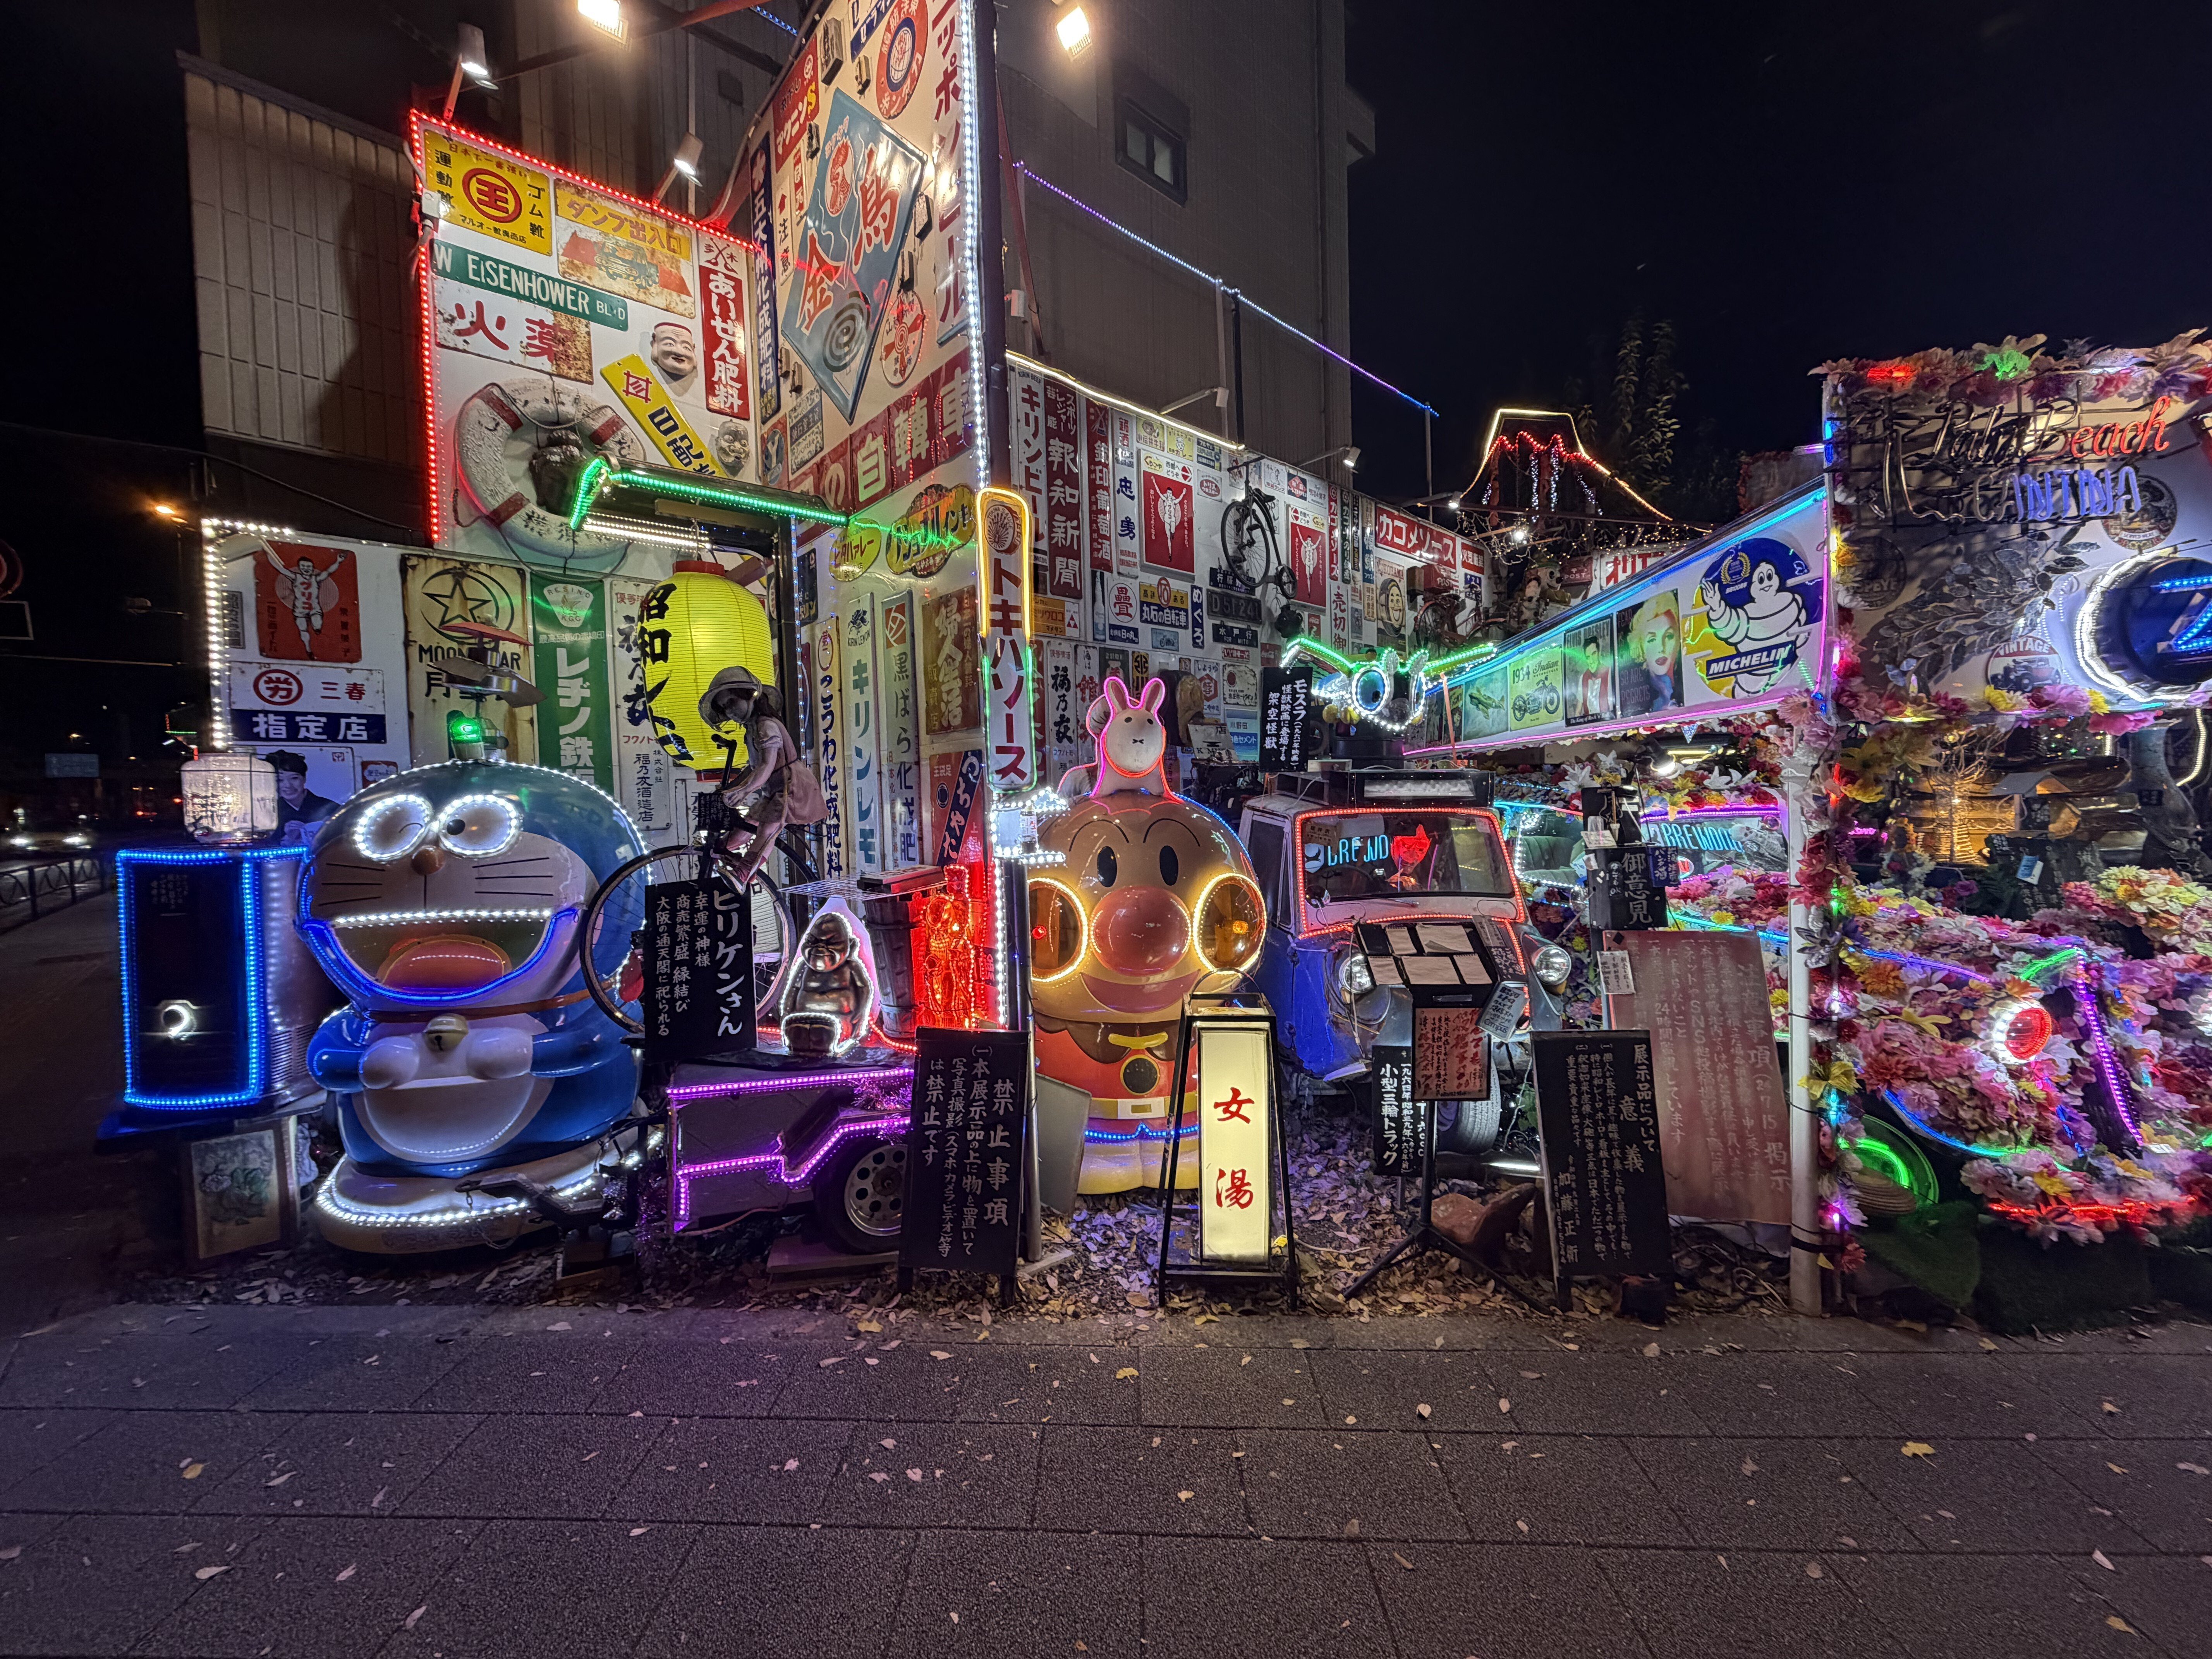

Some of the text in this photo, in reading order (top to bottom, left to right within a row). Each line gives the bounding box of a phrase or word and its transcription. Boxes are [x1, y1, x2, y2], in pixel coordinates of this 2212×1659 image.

[527, 184, 545, 239] ゴム靴
[568, 199, 683, 254] ダンプ出入口
[434, 244, 626, 321] W EISENHOWER BLD
[1067, 393, 1077, 435] スポーツ
[2023, 395, 2170, 462] Beach
[988, 507, 1013, 530] TOKIWA SAUCE
[1048, 438, 1080, 592] 報知新聞
[1116, 476, 1136, 541] 忠勇
[1977, 467, 2142, 522] CANTINA
[1379, 514, 1455, 565] カゴメソース
[547, 585, 591, 598] RESINO
[1437, 577, 1453, 587] POST
[1142, 603, 1187, 627] 丸石の自転車
[1219, 626, 1252, 639] 水戸行
[934, 597, 963, 727] 婦人生活
[989, 558, 1028, 781] トキハソース
[1513, 665, 1530, 684] 1934
[1709, 643, 1793, 675] MICHELIN
[1994, 636, 2052, 657] VINTAGE
[321, 681, 366, 701] 三春
[1264, 691, 1280, 749] 架空怪獣
[252, 713, 368, 740] 指定店
[1279, 684, 1292, 761] 怪獣映画に登場する
[1621, 852, 1653, 925] 御意見
[672, 893, 692, 1012] 商売繁盛 縁結び
[694, 891, 711, 967] 幸運の神様
[656, 896, 672, 1036] 大阪の通天閣に祀られる
[1484, 1018, 1508, 1033] Campus
[921, 1058, 945, 1167] は禁止です
[1379, 1063, 1399, 1167] 小型三輪トラック
[1633, 1044, 1656, 1152] 展示品について
[983, 1078, 1016, 1226] 禁止事項
[1213, 1086, 1255, 1211] 女湯
